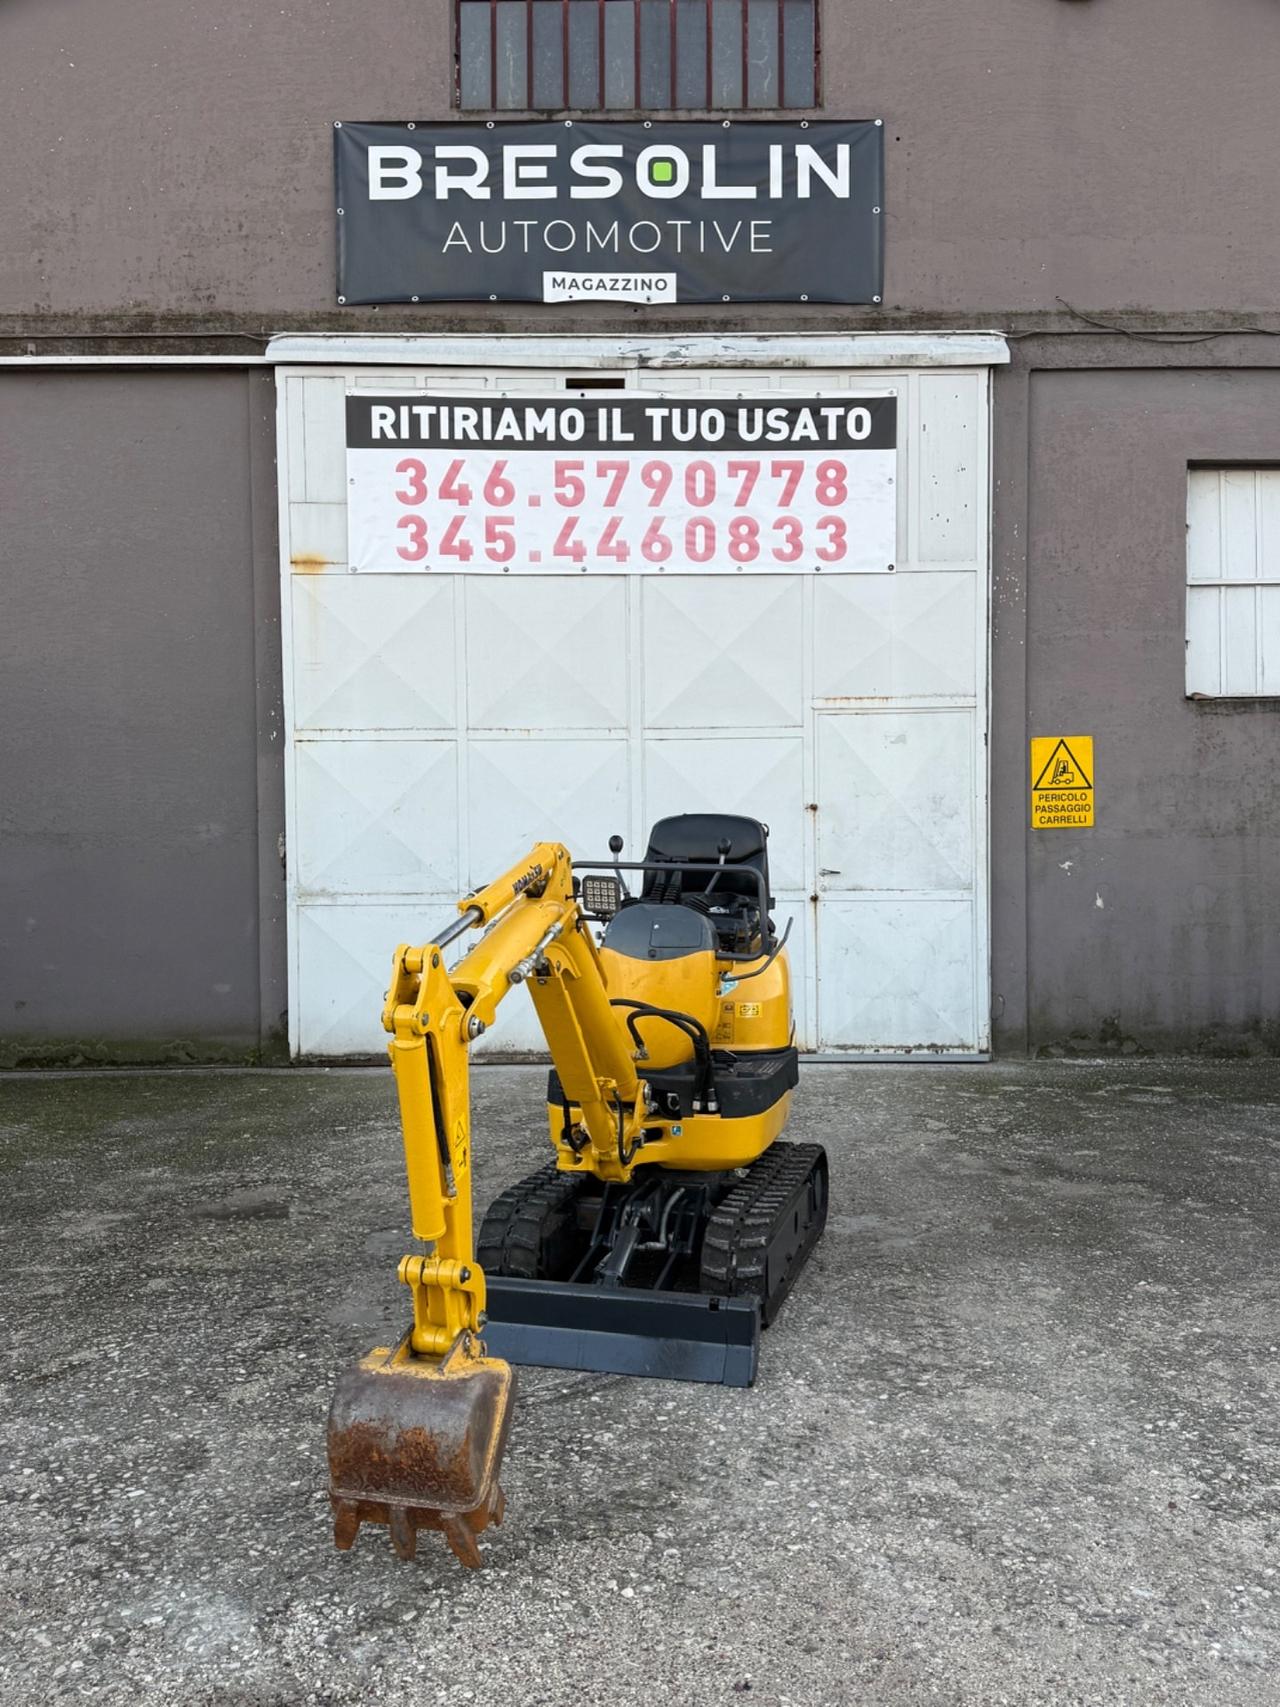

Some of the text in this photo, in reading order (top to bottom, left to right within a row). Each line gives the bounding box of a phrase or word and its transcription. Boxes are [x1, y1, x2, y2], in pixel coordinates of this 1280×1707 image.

[367, 143, 851, 201] BRESOLIN
[441, 219, 773, 254] AUTOMOTIVE
[551, 276, 669, 291] MAGAZZINO
[370, 405, 873, 443] RITIRIAMO IL TUO USATO
[395, 457, 849, 508] 346.5790778
[396, 514, 849, 564] 345.4460833
[1035, 803, 1092, 814] PASSAGGIO
[1038, 792, 1088, 802] PERICOLO
[1039, 814, 1087, 825] CARRELLI
